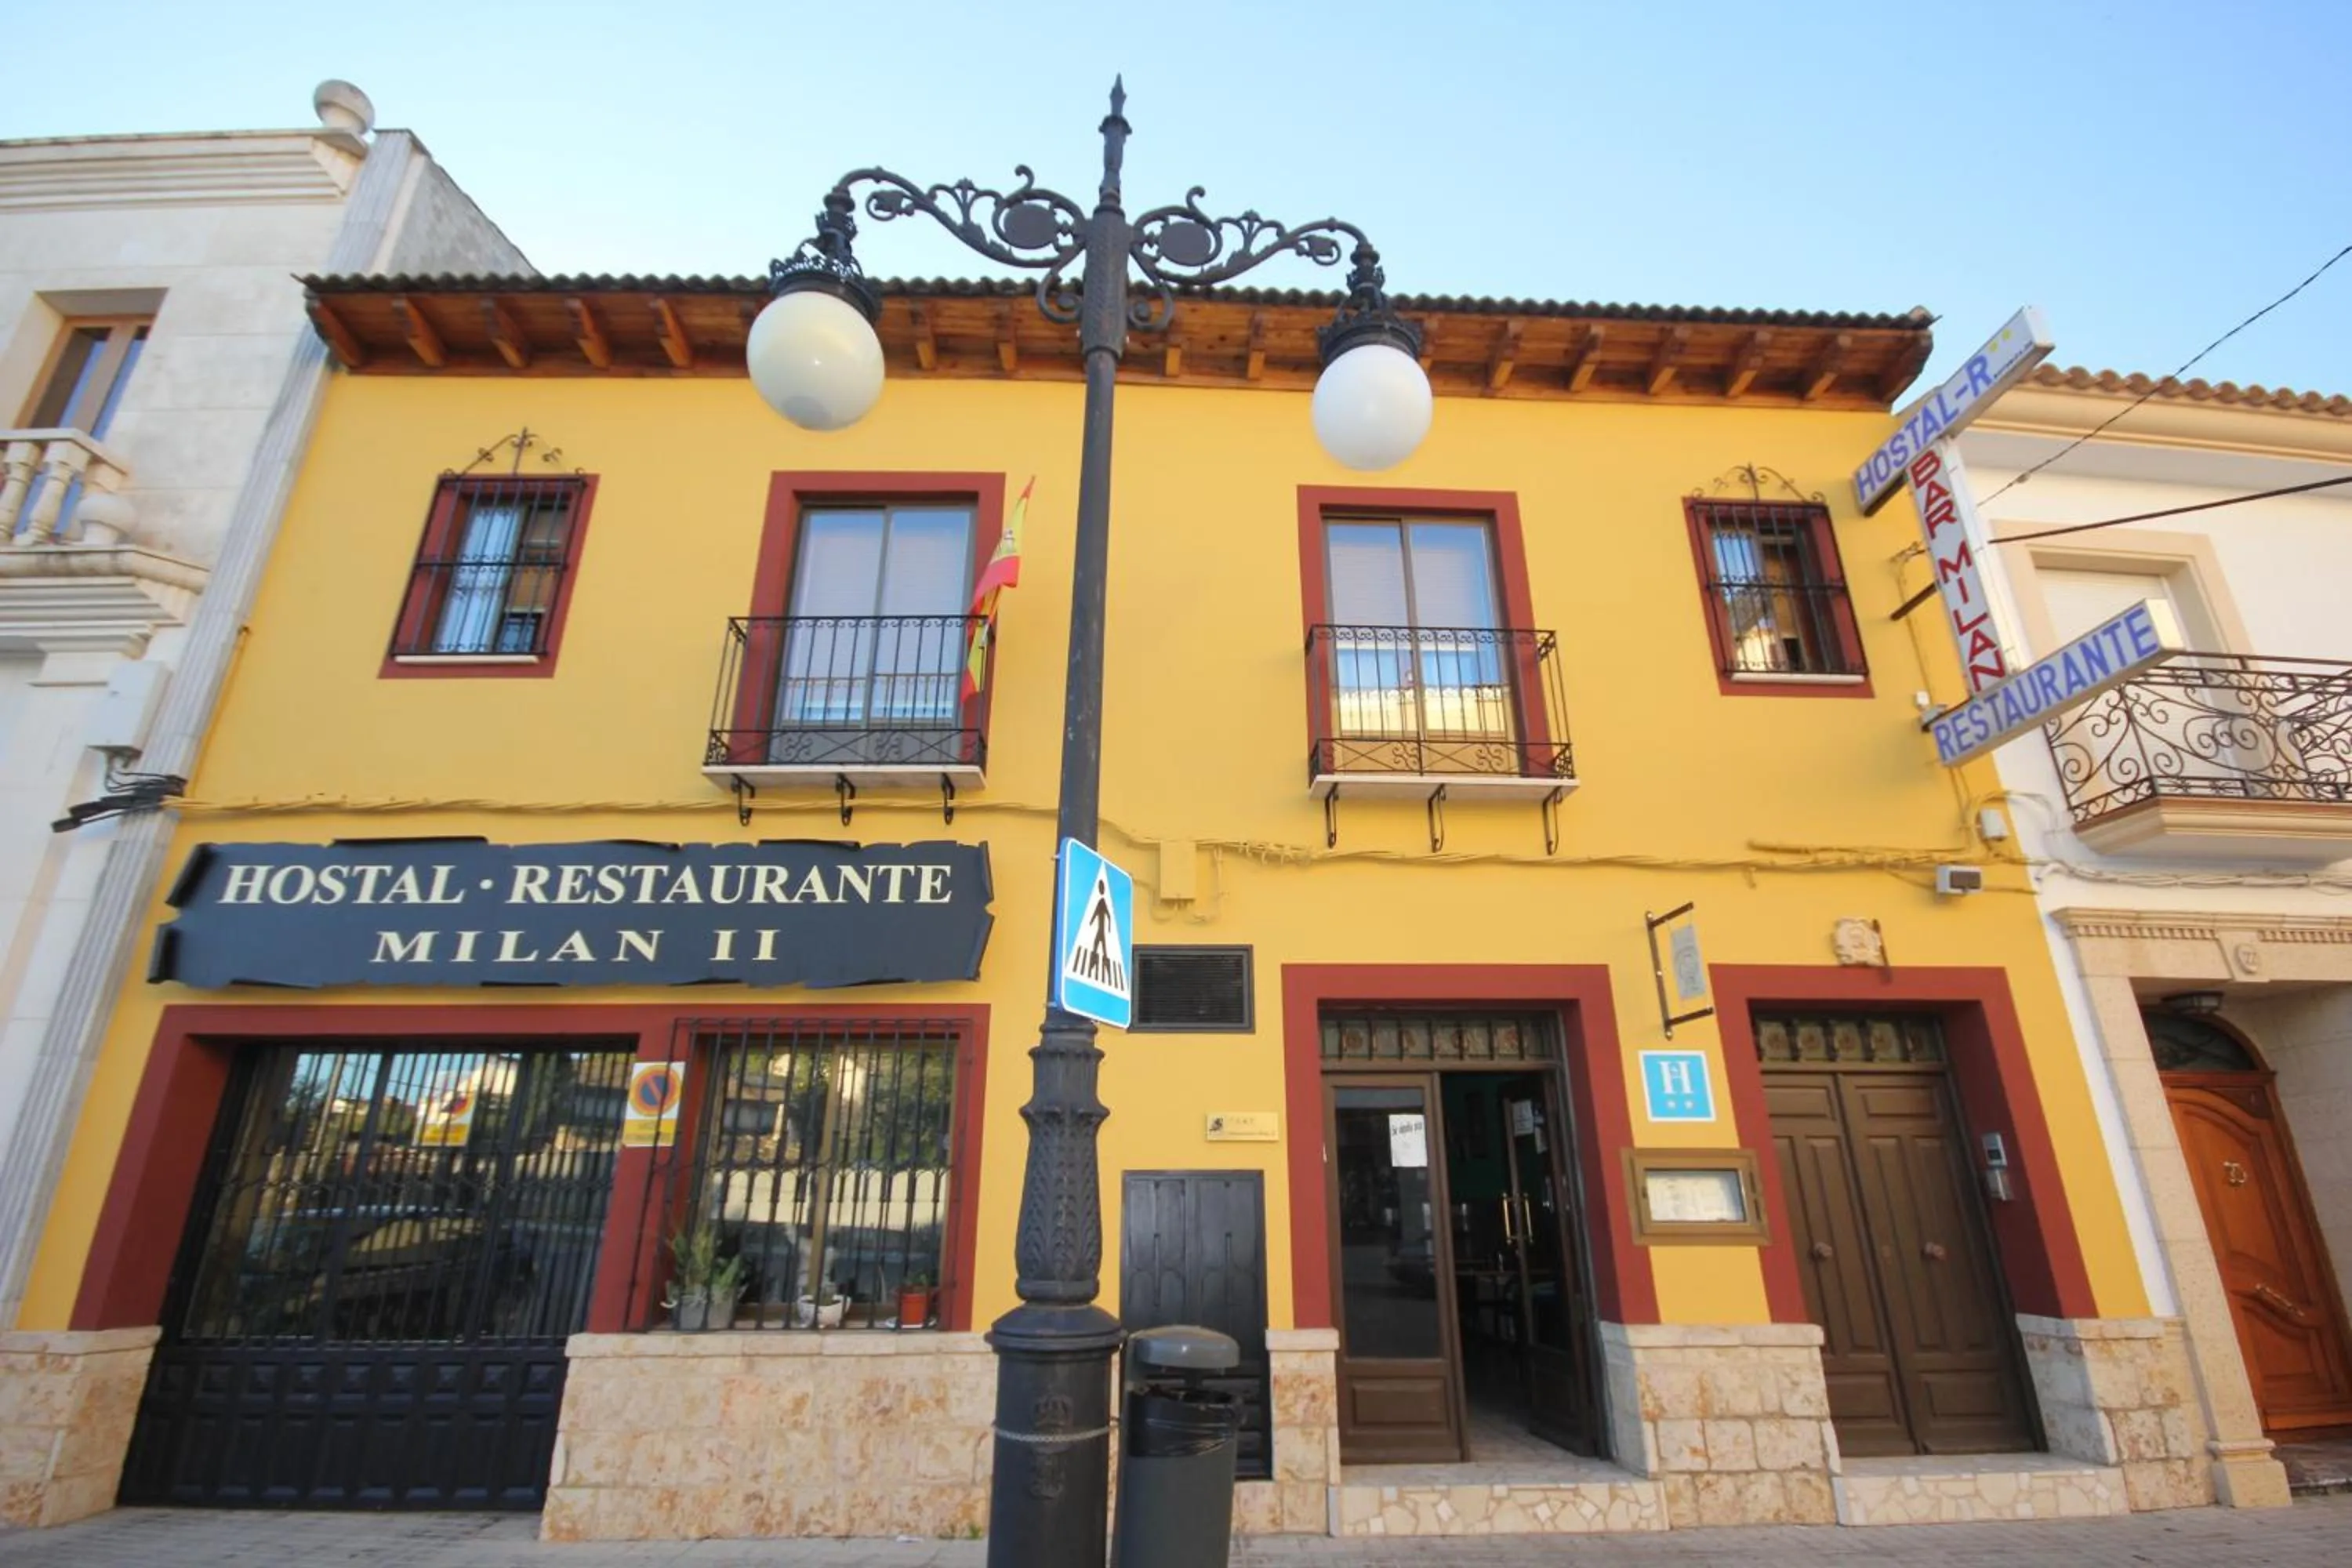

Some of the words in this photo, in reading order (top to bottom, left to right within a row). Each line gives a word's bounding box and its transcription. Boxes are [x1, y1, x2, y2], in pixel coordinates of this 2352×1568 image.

[1857, 355, 1993, 502] HOSTAL-R
[1911, 450, 1958, 540] BAR
[1938, 540, 2006, 693] MILAN
[1933, 608, 2158, 762] RESTAURANTE
[216, 864, 466, 904] HOSTAL
[505, 864, 953, 905] RESTAURANTE
[368, 930, 665, 963] MILAN
[709, 929, 782, 962] II
